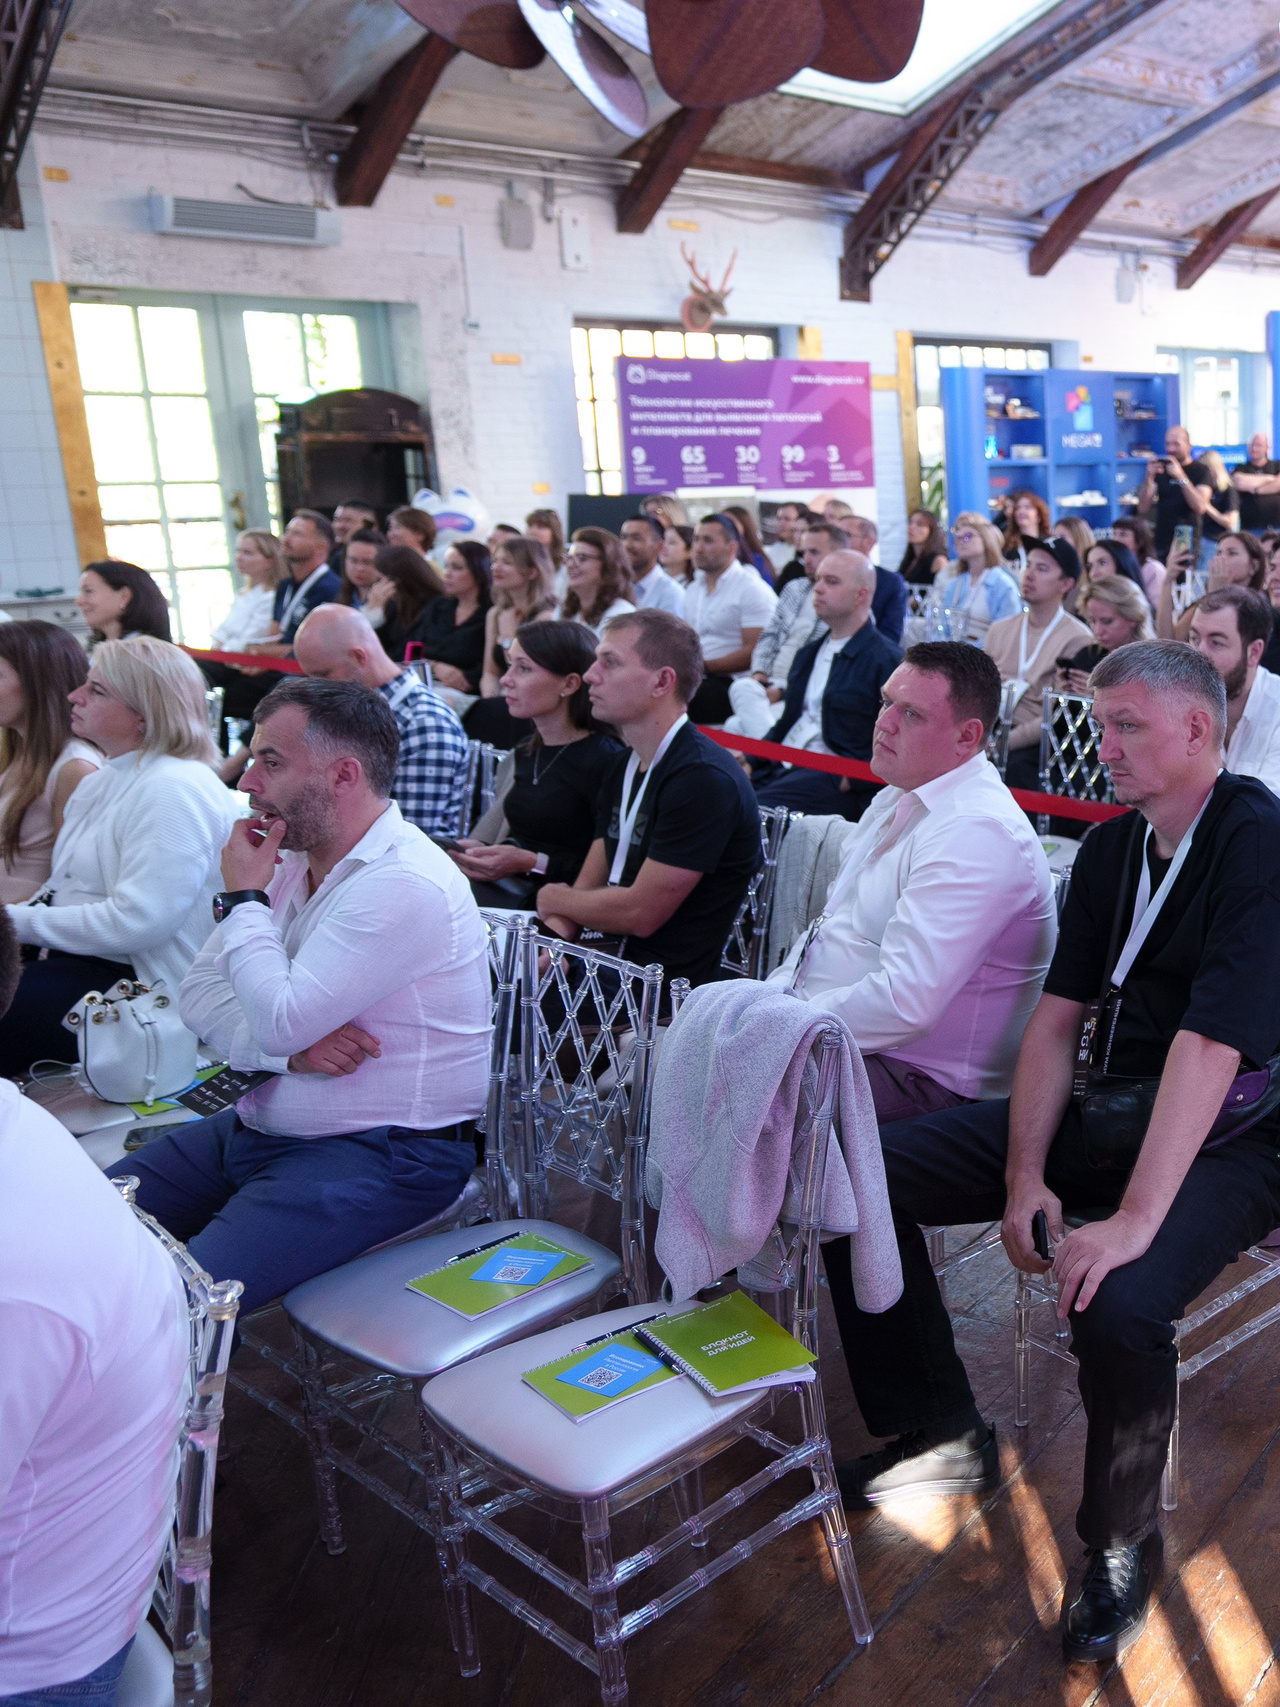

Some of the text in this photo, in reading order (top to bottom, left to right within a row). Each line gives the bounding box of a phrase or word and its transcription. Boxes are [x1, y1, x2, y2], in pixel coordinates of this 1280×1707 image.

[631, 445, 647, 465] 9
[680, 445, 706, 465] 65
[735, 445, 761, 464] 30
[781, 445, 805, 463] 99
[826, 445, 840, 463] 3
[701, 1330, 750, 1351] БЛОКНОТ
[707, 1335, 756, 1357] ДЛЯ ИДЕЙ
